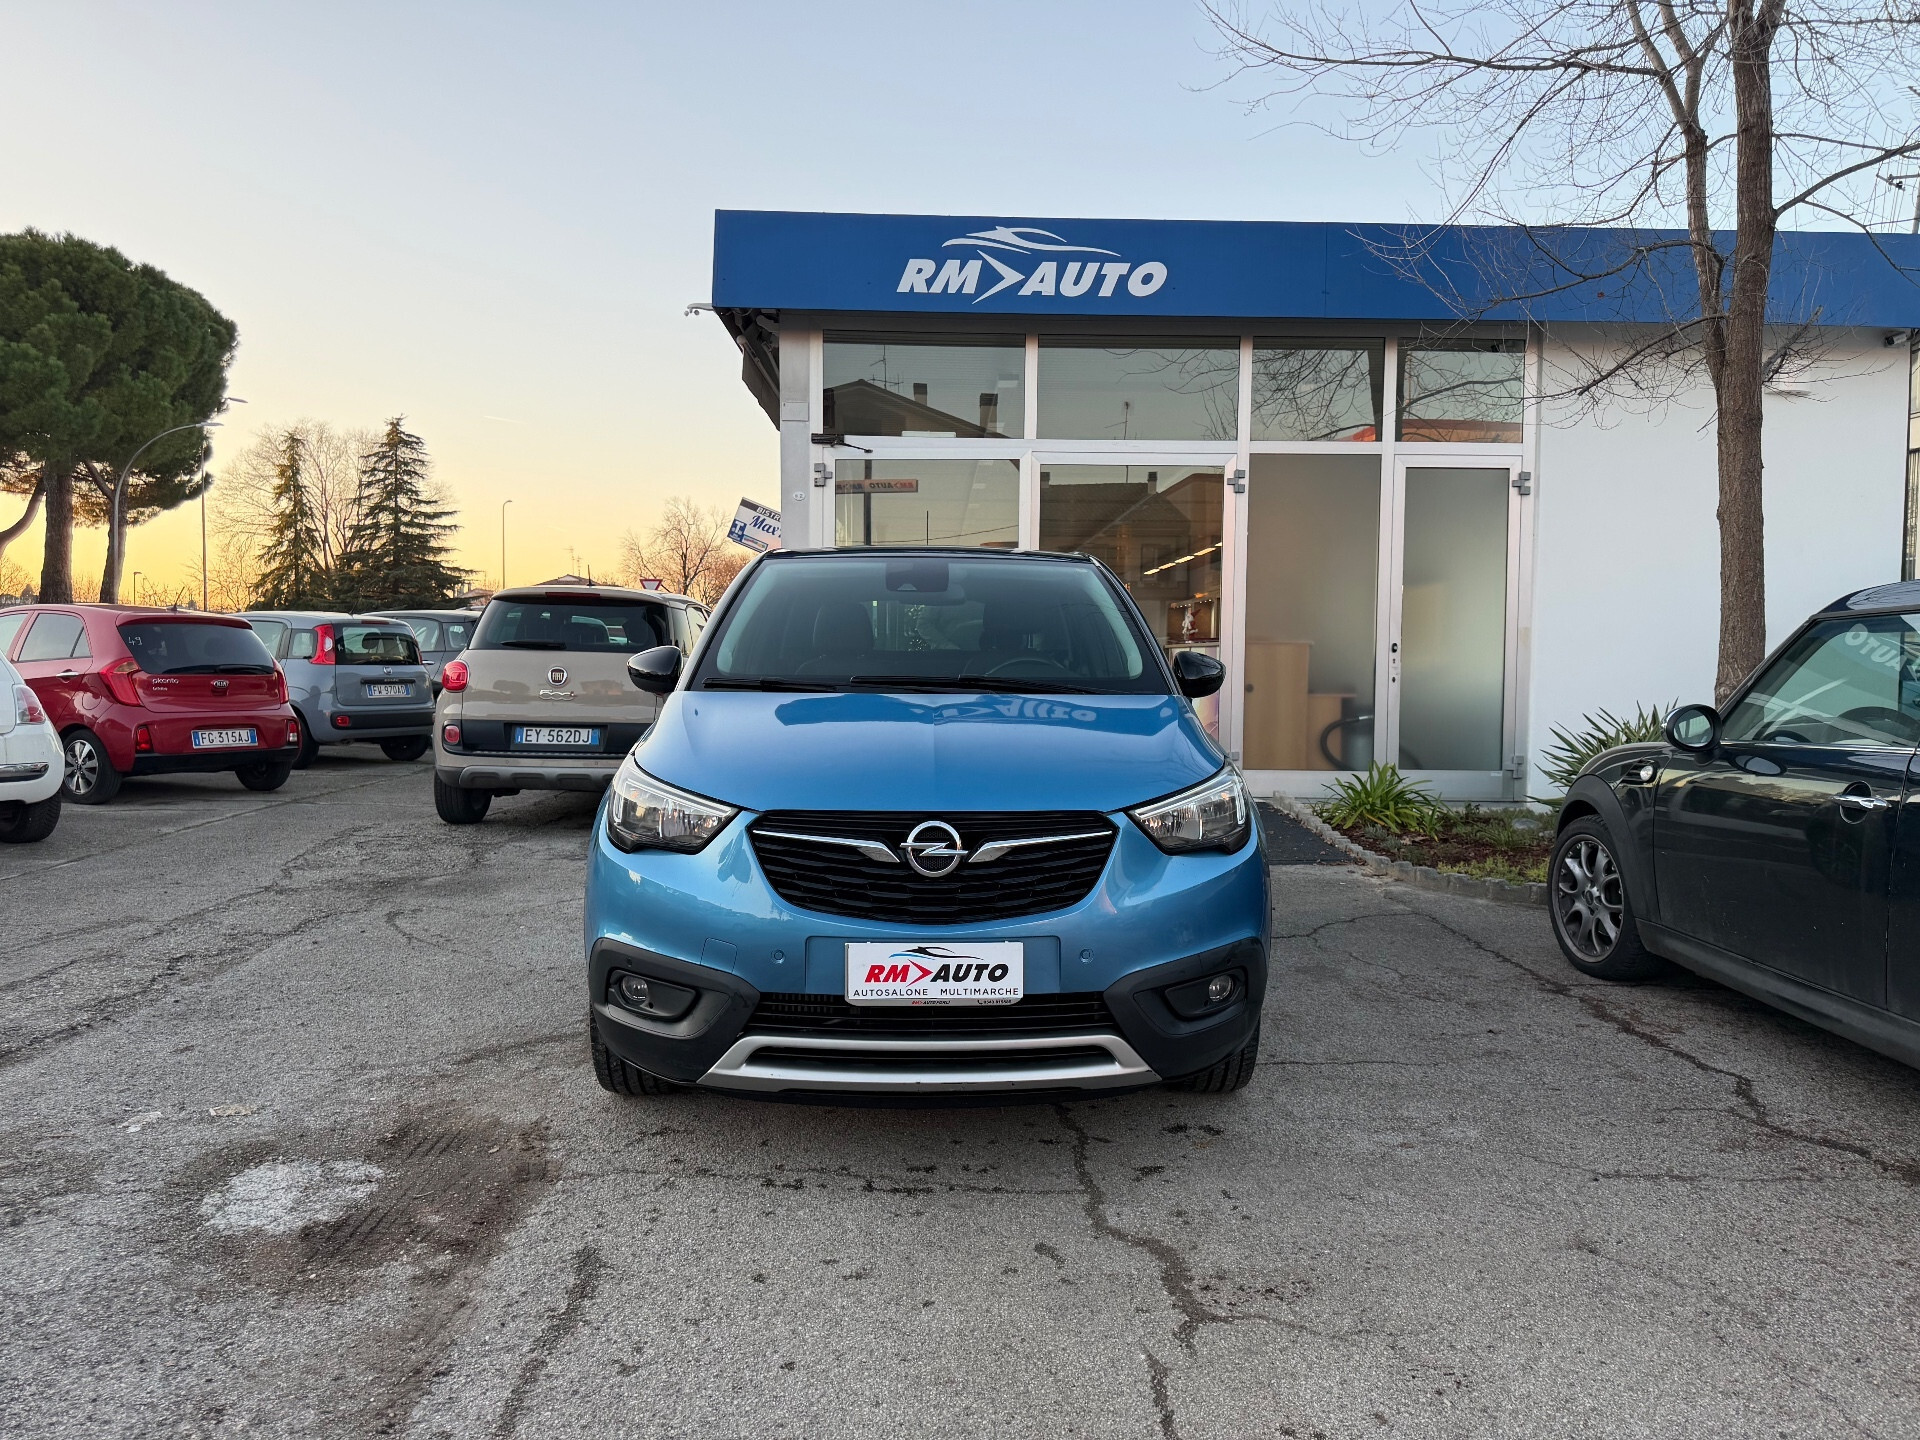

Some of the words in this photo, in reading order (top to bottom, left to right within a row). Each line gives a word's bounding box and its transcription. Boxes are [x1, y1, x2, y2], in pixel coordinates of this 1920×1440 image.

[896, 258, 982, 294] RM
[1017, 261, 1168, 297] AUTO
[552, 672, 564, 680] FIAT
[200, 733, 215, 744] FG
[218, 730, 249, 744] 315AJ
[525, 729, 542, 743] EY
[547, 729, 590, 743] 562DJ
[864, 964, 911, 983] RM
[930, 963, 1009, 983] AUTO
[853, 988, 929, 997] AUTOSALONE
[940, 987, 1019, 996] MULTIMARCHE
